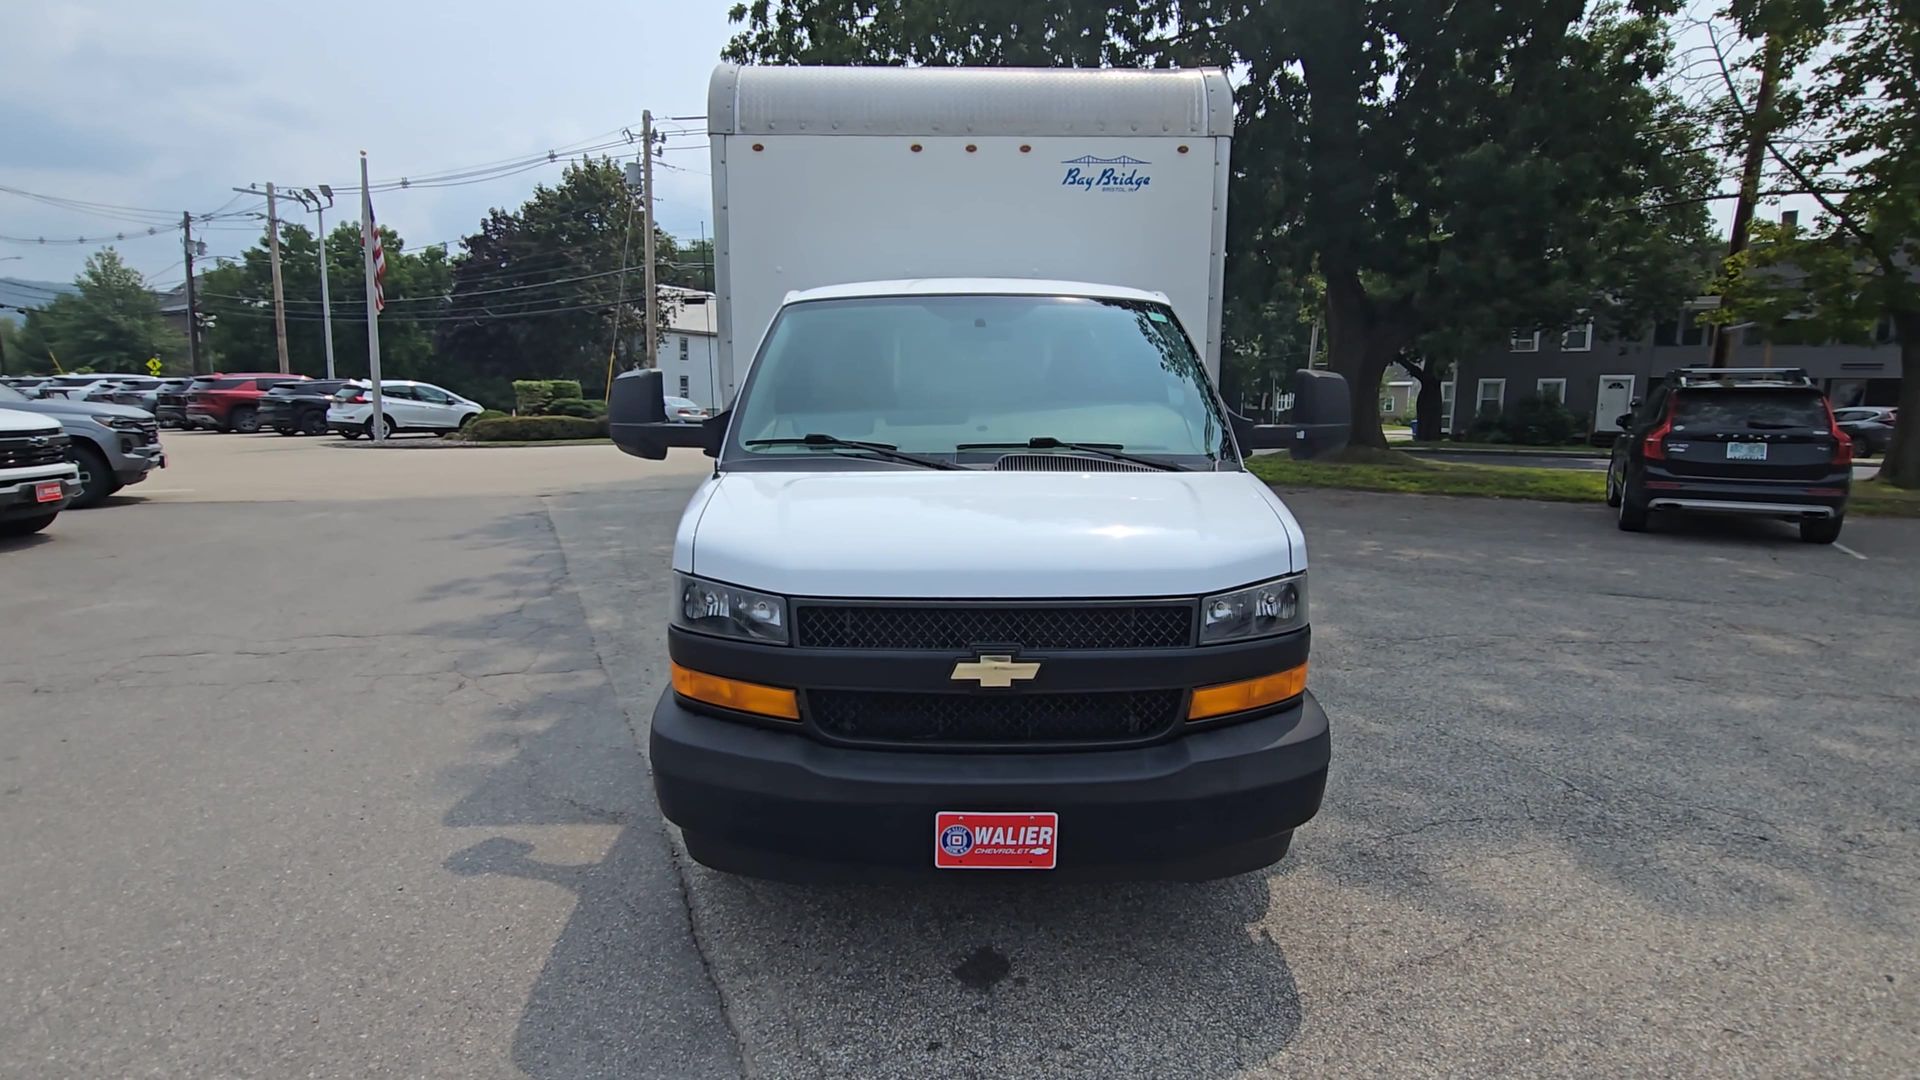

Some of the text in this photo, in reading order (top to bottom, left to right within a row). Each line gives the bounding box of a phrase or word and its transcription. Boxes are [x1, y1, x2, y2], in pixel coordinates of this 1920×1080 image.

[1062, 167, 1151, 191] Bay Bridge
[975, 826, 1053, 845] WALIER
[974, 847, 1030, 855] CHEVROLET
